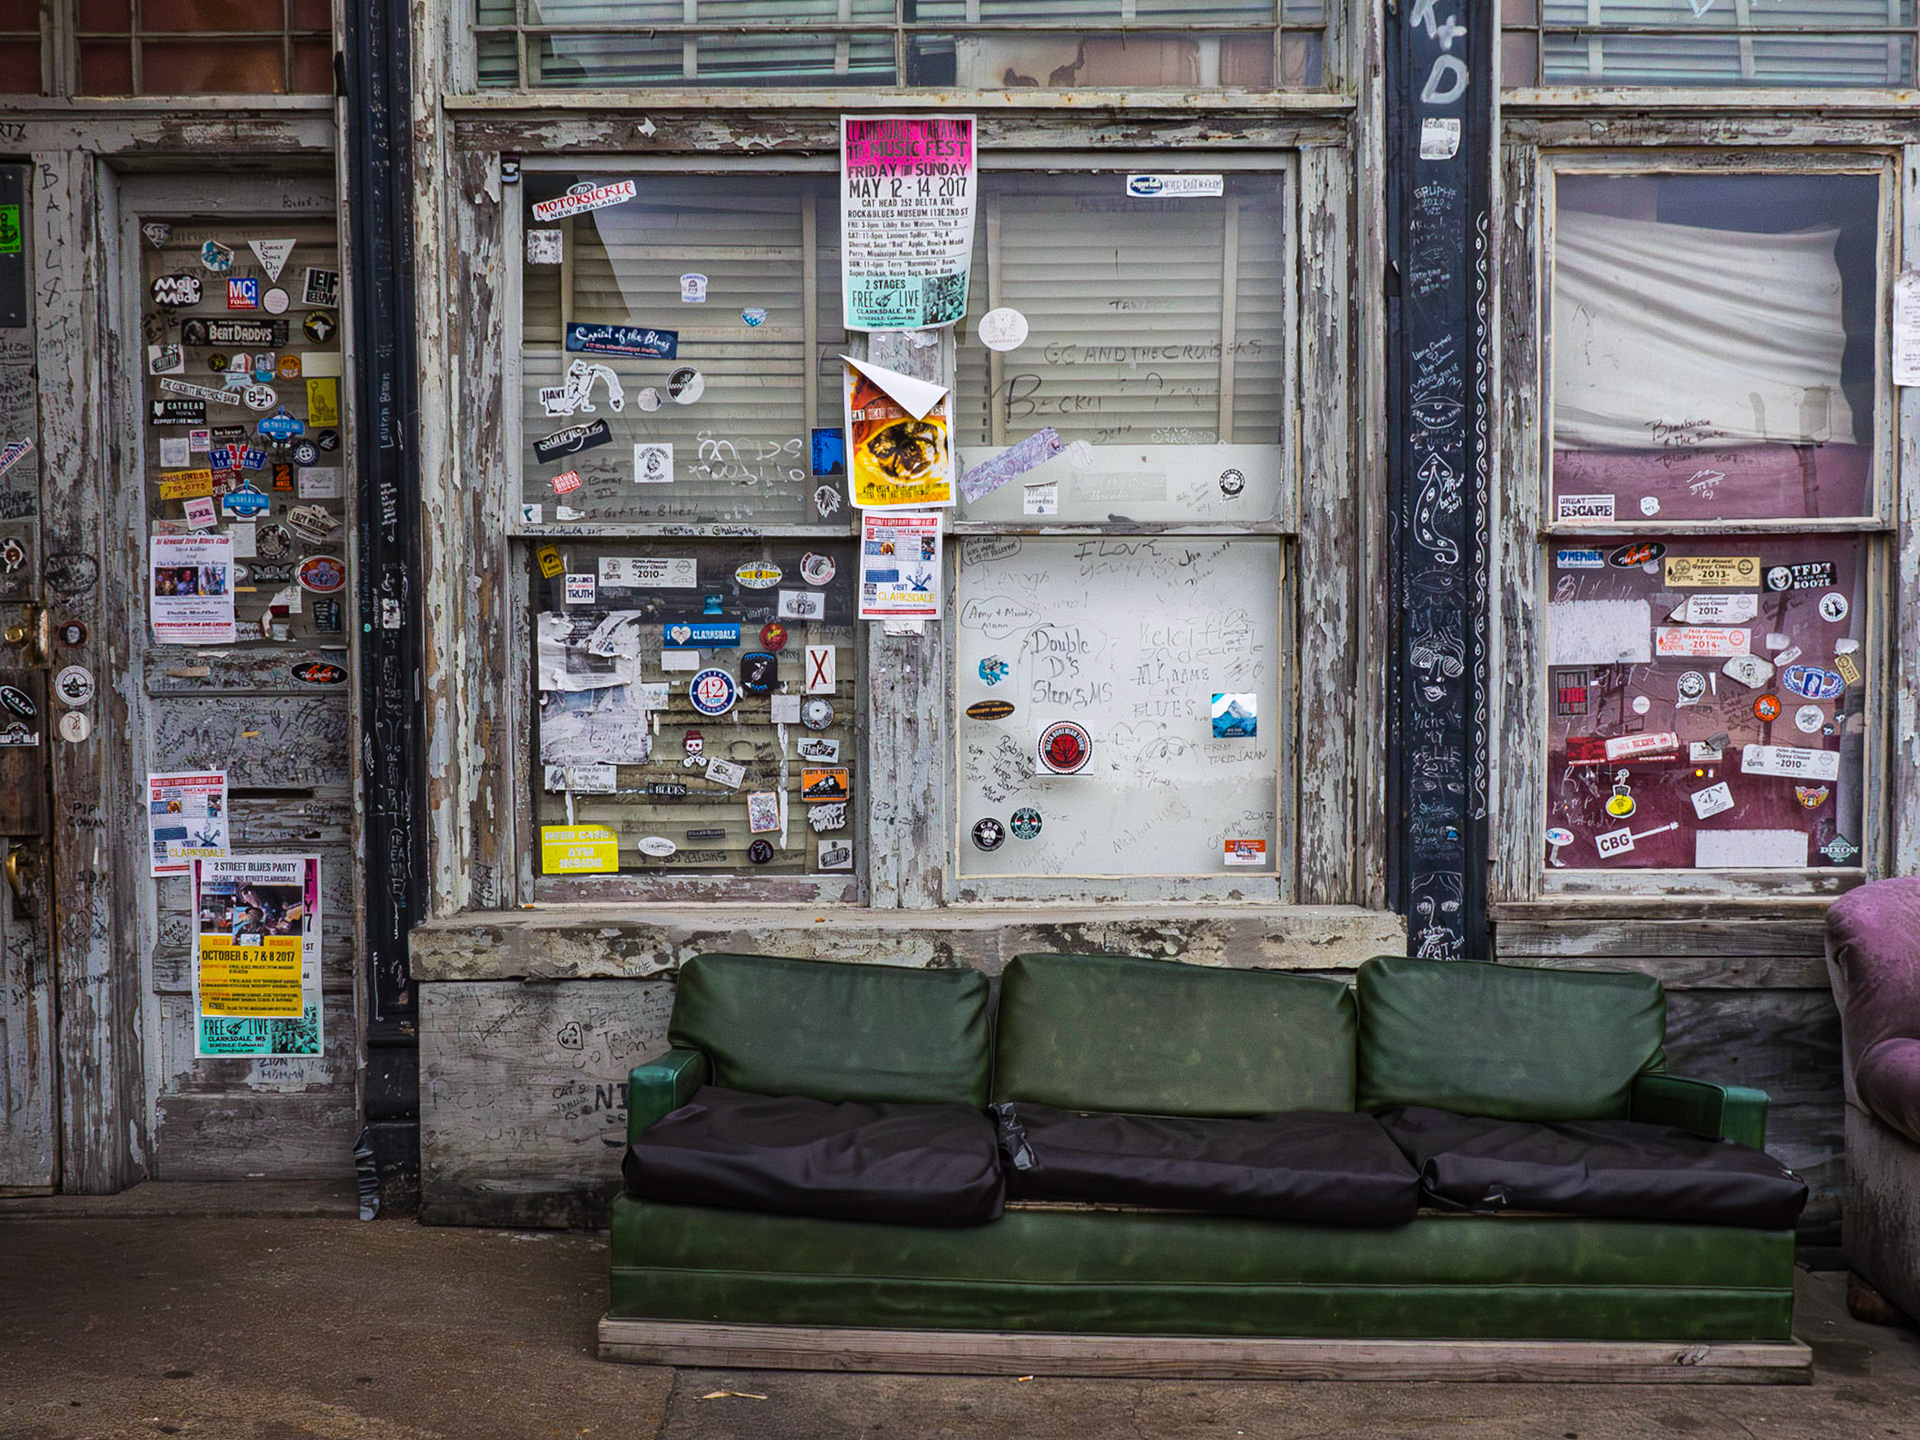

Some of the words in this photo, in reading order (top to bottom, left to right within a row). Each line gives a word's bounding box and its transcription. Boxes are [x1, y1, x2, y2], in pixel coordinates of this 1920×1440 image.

[1421, 54, 1468, 104] D
[870, 141, 920, 157] MUSIC
[926, 140, 968, 157] FEST
[848, 163, 897, 179] FRIDAY
[915, 163, 967, 176] SUNDAY
[849, 178, 881, 198] MAY
[890, 178, 903, 198] 12
[917, 177, 931, 198] 14
[939, 177, 967, 197] 2017
[550, 208, 572, 219] NEW
[576, 197, 623, 213] ZEALAND
[862, 199, 876, 208] CAT
[879, 199, 898, 207] HEAD
[915, 198, 938, 207] DELTA
[940, 197, 955, 206] AVE
[897, 208, 928, 217] MUSEUM
[865, 280, 871, 290] 2
[873, 279, 906, 290] STAGES
[852, 290, 874, 308] FREE
[899, 290, 920, 308] LIVE
[644, 331, 671, 349] Blues
[167, 402, 205, 412] CATHEAD
[1560, 504, 1613, 518] ESCAPE
[1567, 550, 1604, 562] MEMBER
[1793, 578, 1831, 590] BOOZE
[567, 589, 594, 599] TRUTH
[877, 591, 936, 603] CLARKSDALE
[692, 629, 737, 640] CLARKSDALE
[1031, 630, 1091, 655] Double
[698, 678, 725, 699] 42
[654, 785, 687, 796] BLUES
[544, 831, 577, 841] NEED
[1600, 833, 1631, 851] CBG
[168, 847, 226, 858] CLARKSDALE
[567, 847, 596, 858] ATM
[1819, 846, 1859, 854] DIXON
[219, 862, 247, 872] STREET
[248, 862, 271, 872] BLUES
[272, 862, 297, 873] PARTY
[558, 858, 604, 869] INSIDE
[202, 950, 241, 962] OCTOBER
[275, 950, 296, 962] 2017
[203, 1019, 225, 1036] FREE
[248, 1018, 269, 1036] LIVE
